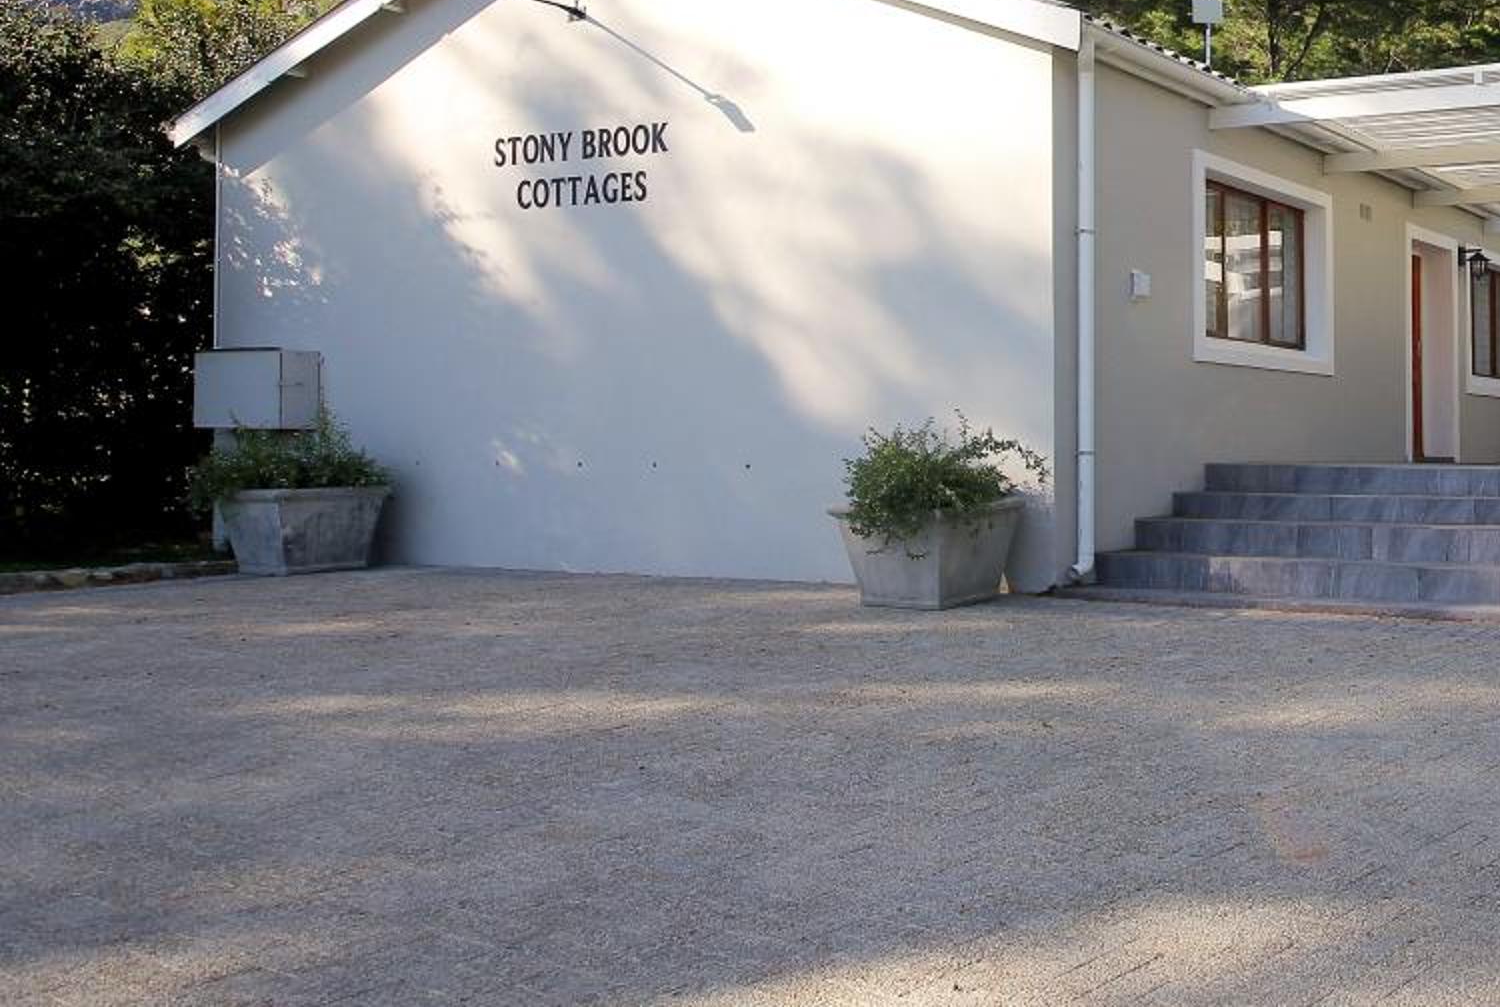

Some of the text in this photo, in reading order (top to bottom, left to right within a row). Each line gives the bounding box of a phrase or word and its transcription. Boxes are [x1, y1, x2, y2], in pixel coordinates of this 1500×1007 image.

[494, 122, 669, 167] STONY BROOK
[516, 170, 647, 209] COTTAGES
